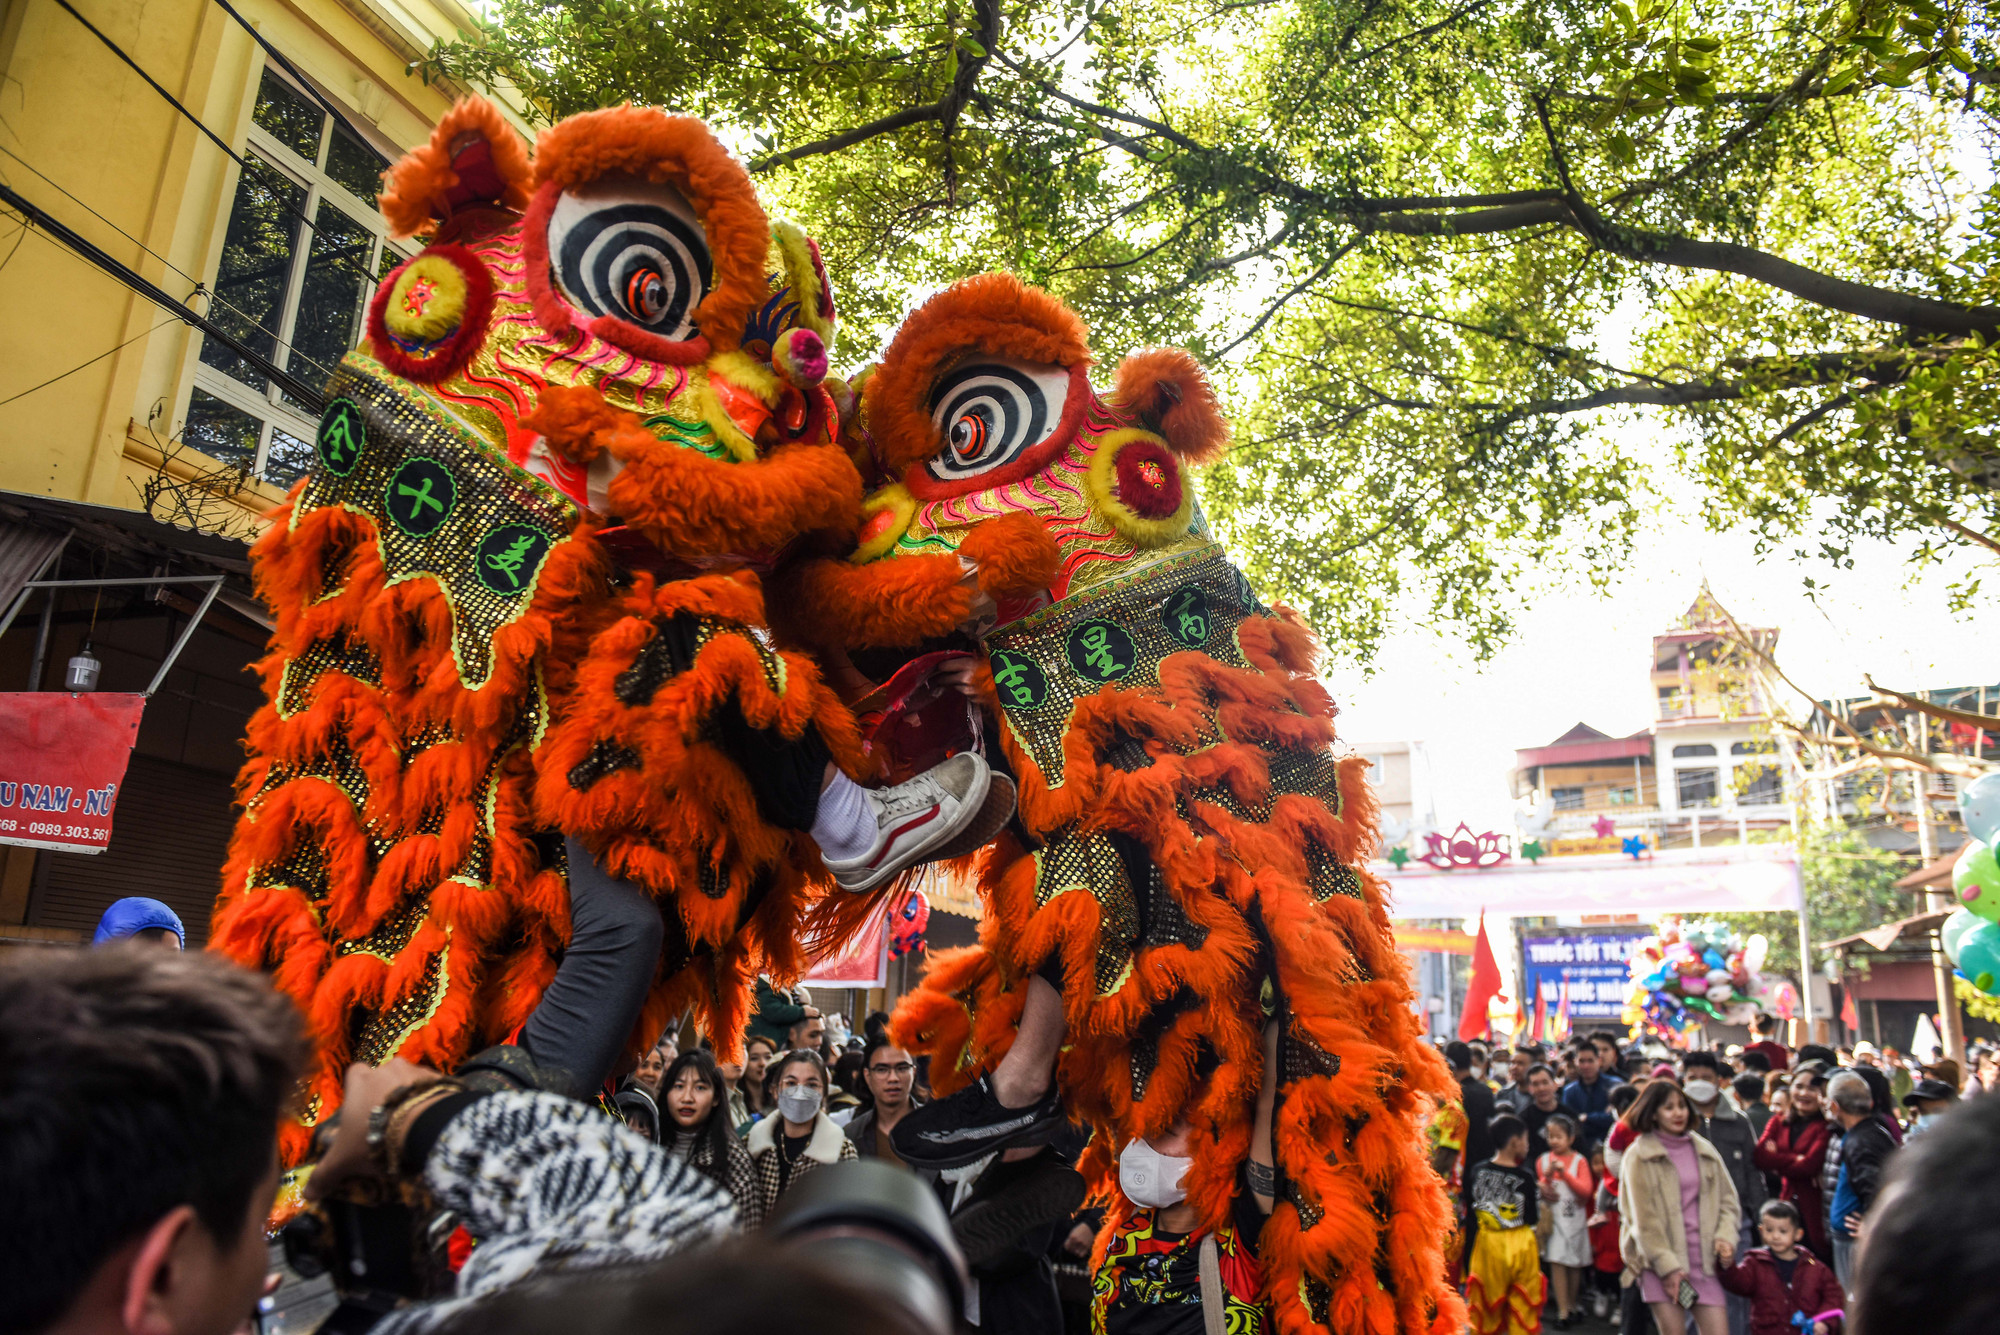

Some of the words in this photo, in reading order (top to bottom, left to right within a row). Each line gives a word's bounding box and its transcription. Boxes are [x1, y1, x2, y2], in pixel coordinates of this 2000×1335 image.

[398, 477, 444, 519] 十
[485, 534, 536, 588] 美
[994, 654, 1032, 705] 吉
[1080, 626, 1126, 677] 星
[1171, 592, 1206, 641] 高
[0, 819, 18, 831] 68
[29, 822, 110, 841] 0989.303.561
[20, 783, 73, 813] NAM
[83, 783, 116, 817] NỮ
